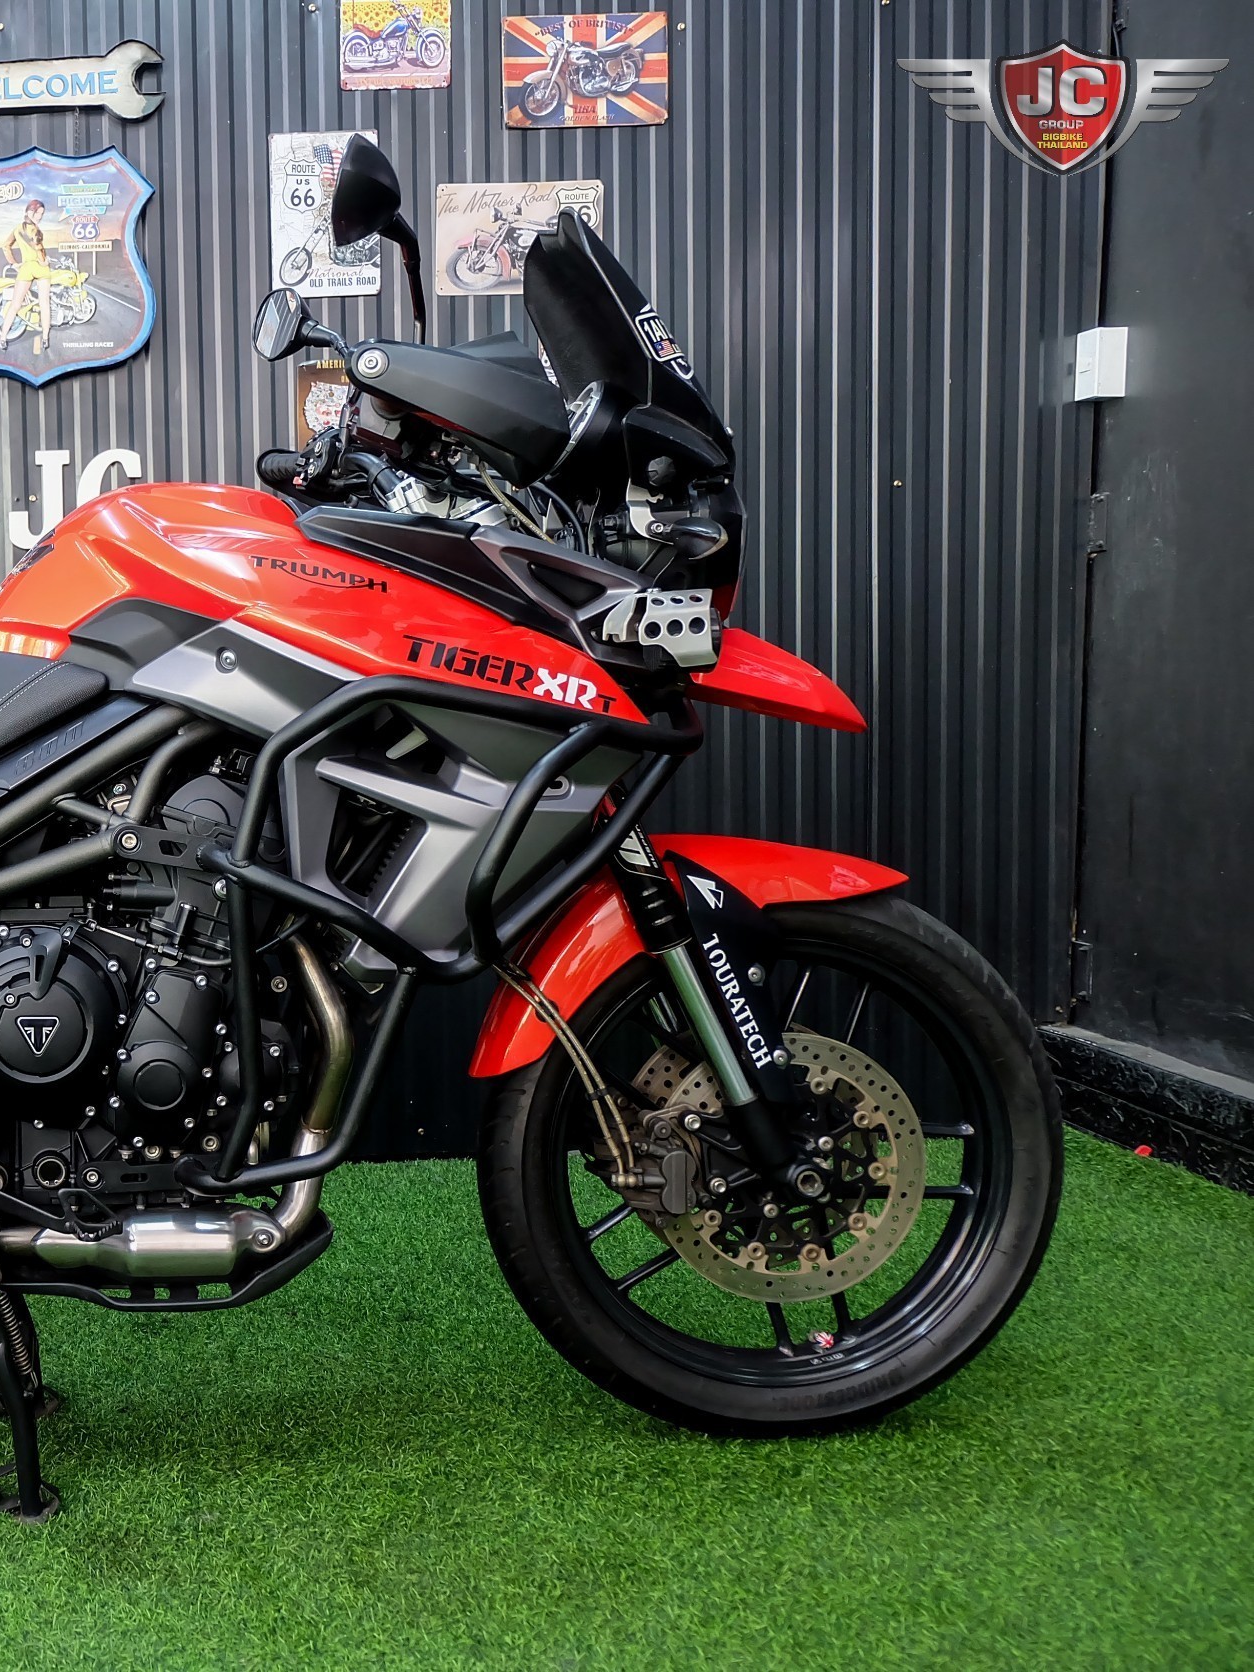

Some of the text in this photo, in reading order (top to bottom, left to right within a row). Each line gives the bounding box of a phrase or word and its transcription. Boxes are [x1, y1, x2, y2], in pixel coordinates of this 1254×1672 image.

[568, 19, 583, 29] OF
[291, 163, 316, 174] ROUTE
[296, 178, 311, 186] US
[290, 188, 316, 208] 66
[438, 184, 556, 218] The Mother Road
[564, 193, 590, 201] ROUTE
[75, 215, 95, 223] ROUTE
[74, 223, 96, 239] 66
[307, 266, 365, 279] National
[309, 276, 377, 288] OLD TRAILS ROAD
[249, 554, 388, 594] TRIUMPH
[702, 932, 773, 1070] TOURATECH
